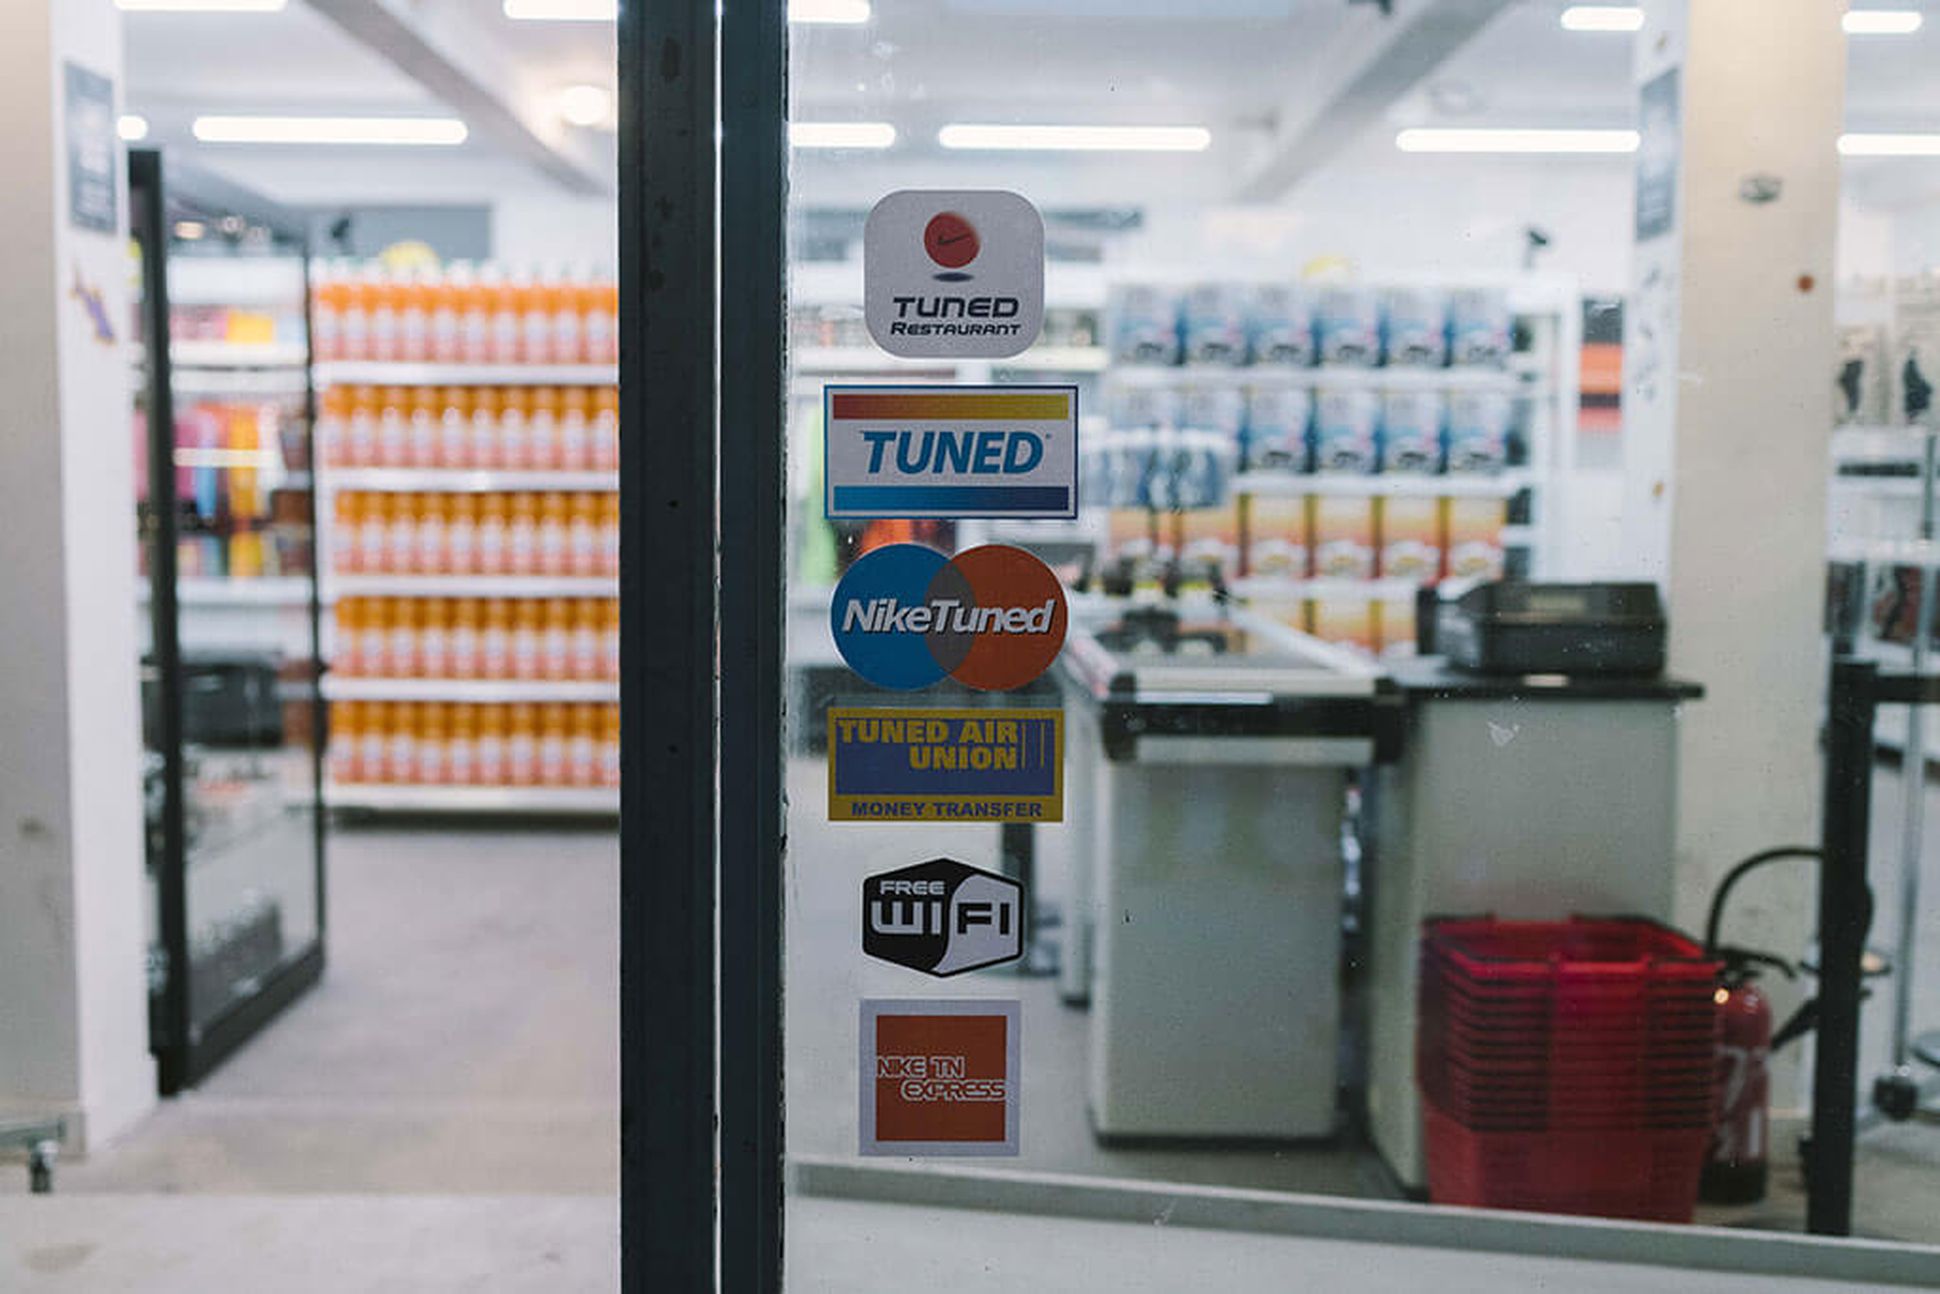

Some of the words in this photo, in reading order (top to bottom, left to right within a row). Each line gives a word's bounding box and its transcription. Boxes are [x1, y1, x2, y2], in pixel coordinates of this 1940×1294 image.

[893, 297, 1020, 318] TUNED
[863, 431, 1044, 474] TUNED
[842, 598, 1056, 635] NikeTuned
[838, 720, 948, 743] TUNED
[959, 720, 1018, 743] AIR
[909, 746, 1017, 769] UNION
[851, 802, 926, 816] MONEY
[933, 802, 1042, 817] TRANSFER
[880, 880, 945, 895] FREE
[901, 1079, 1007, 1101] EXPRESS
